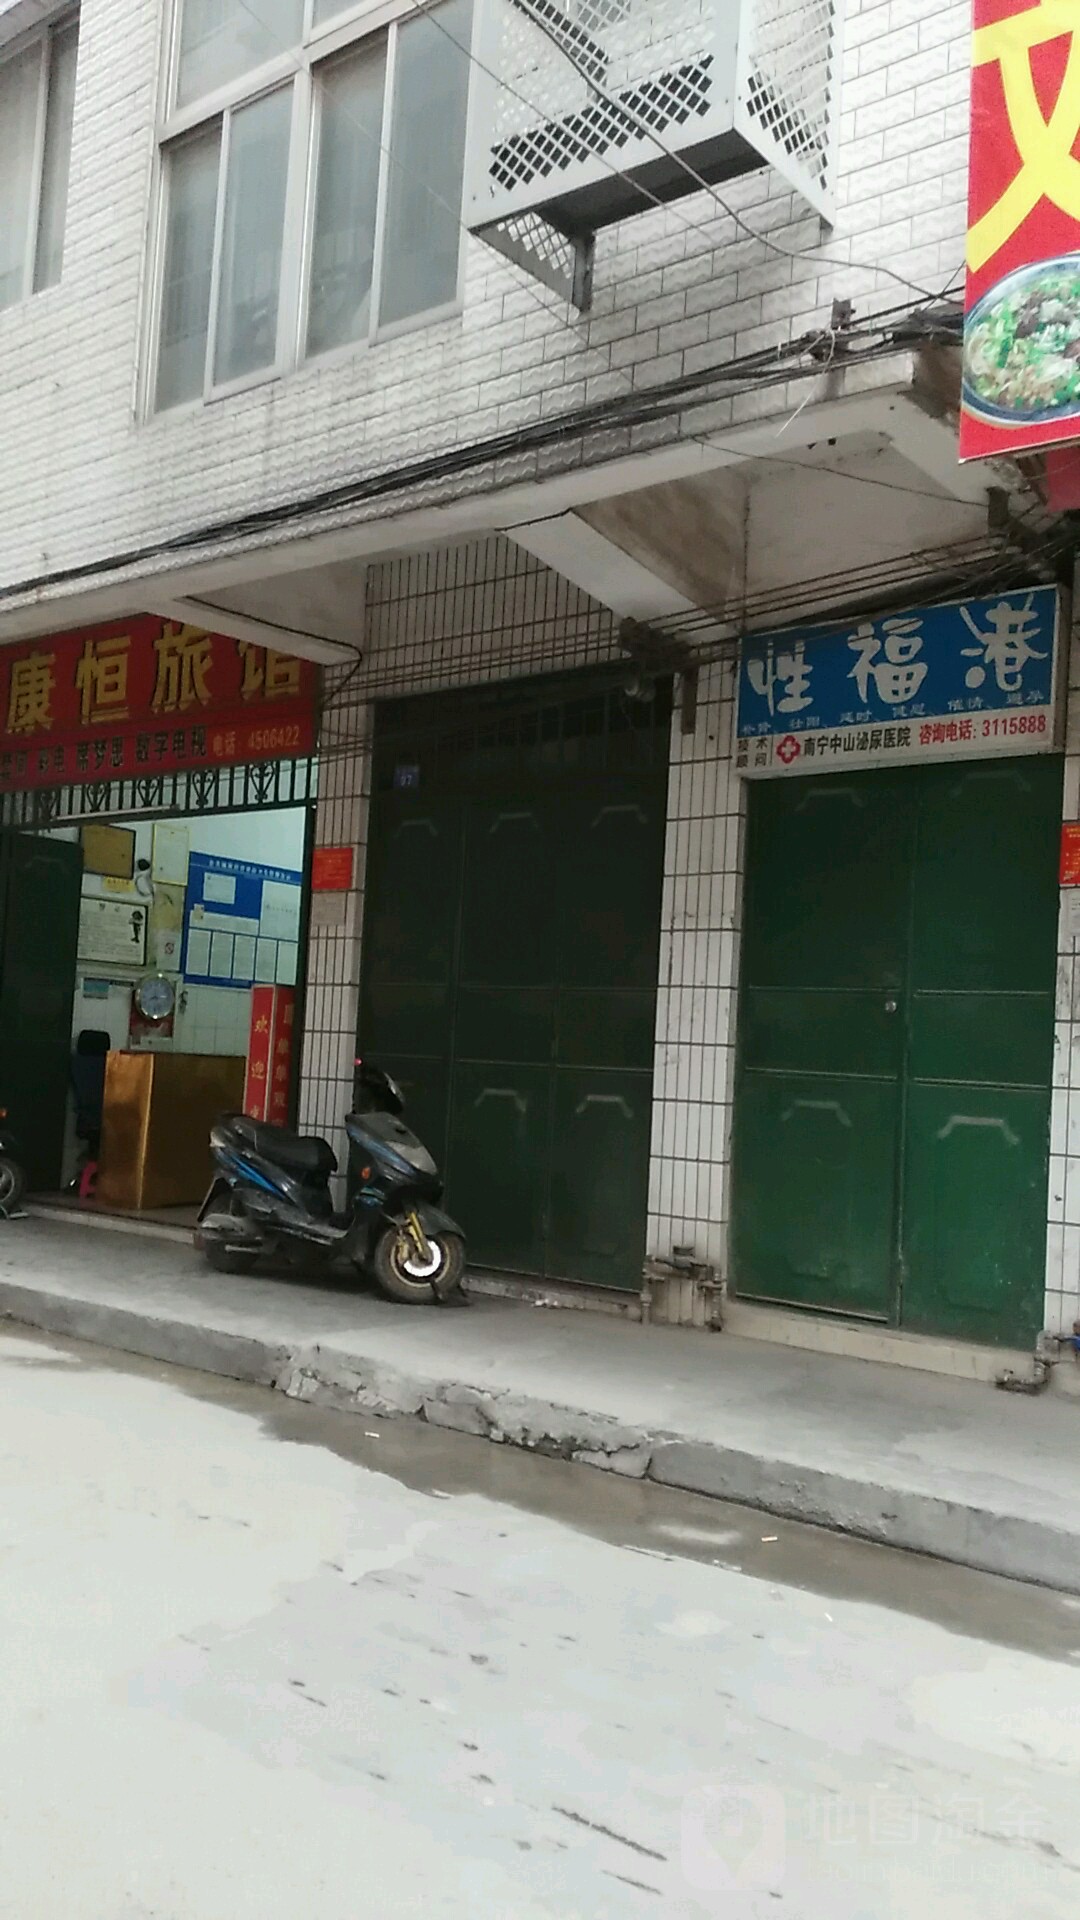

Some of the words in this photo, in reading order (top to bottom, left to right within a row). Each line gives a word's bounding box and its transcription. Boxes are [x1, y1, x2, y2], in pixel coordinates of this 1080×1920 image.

[748, 593, 1049, 717] 性福港
[135, 724, 206, 763] 数字电视
[213, 731, 236, 756] 电话
[248, 725, 300, 750] 4506422
[804, 727, 911, 756] 南宁中山泌尿医院
